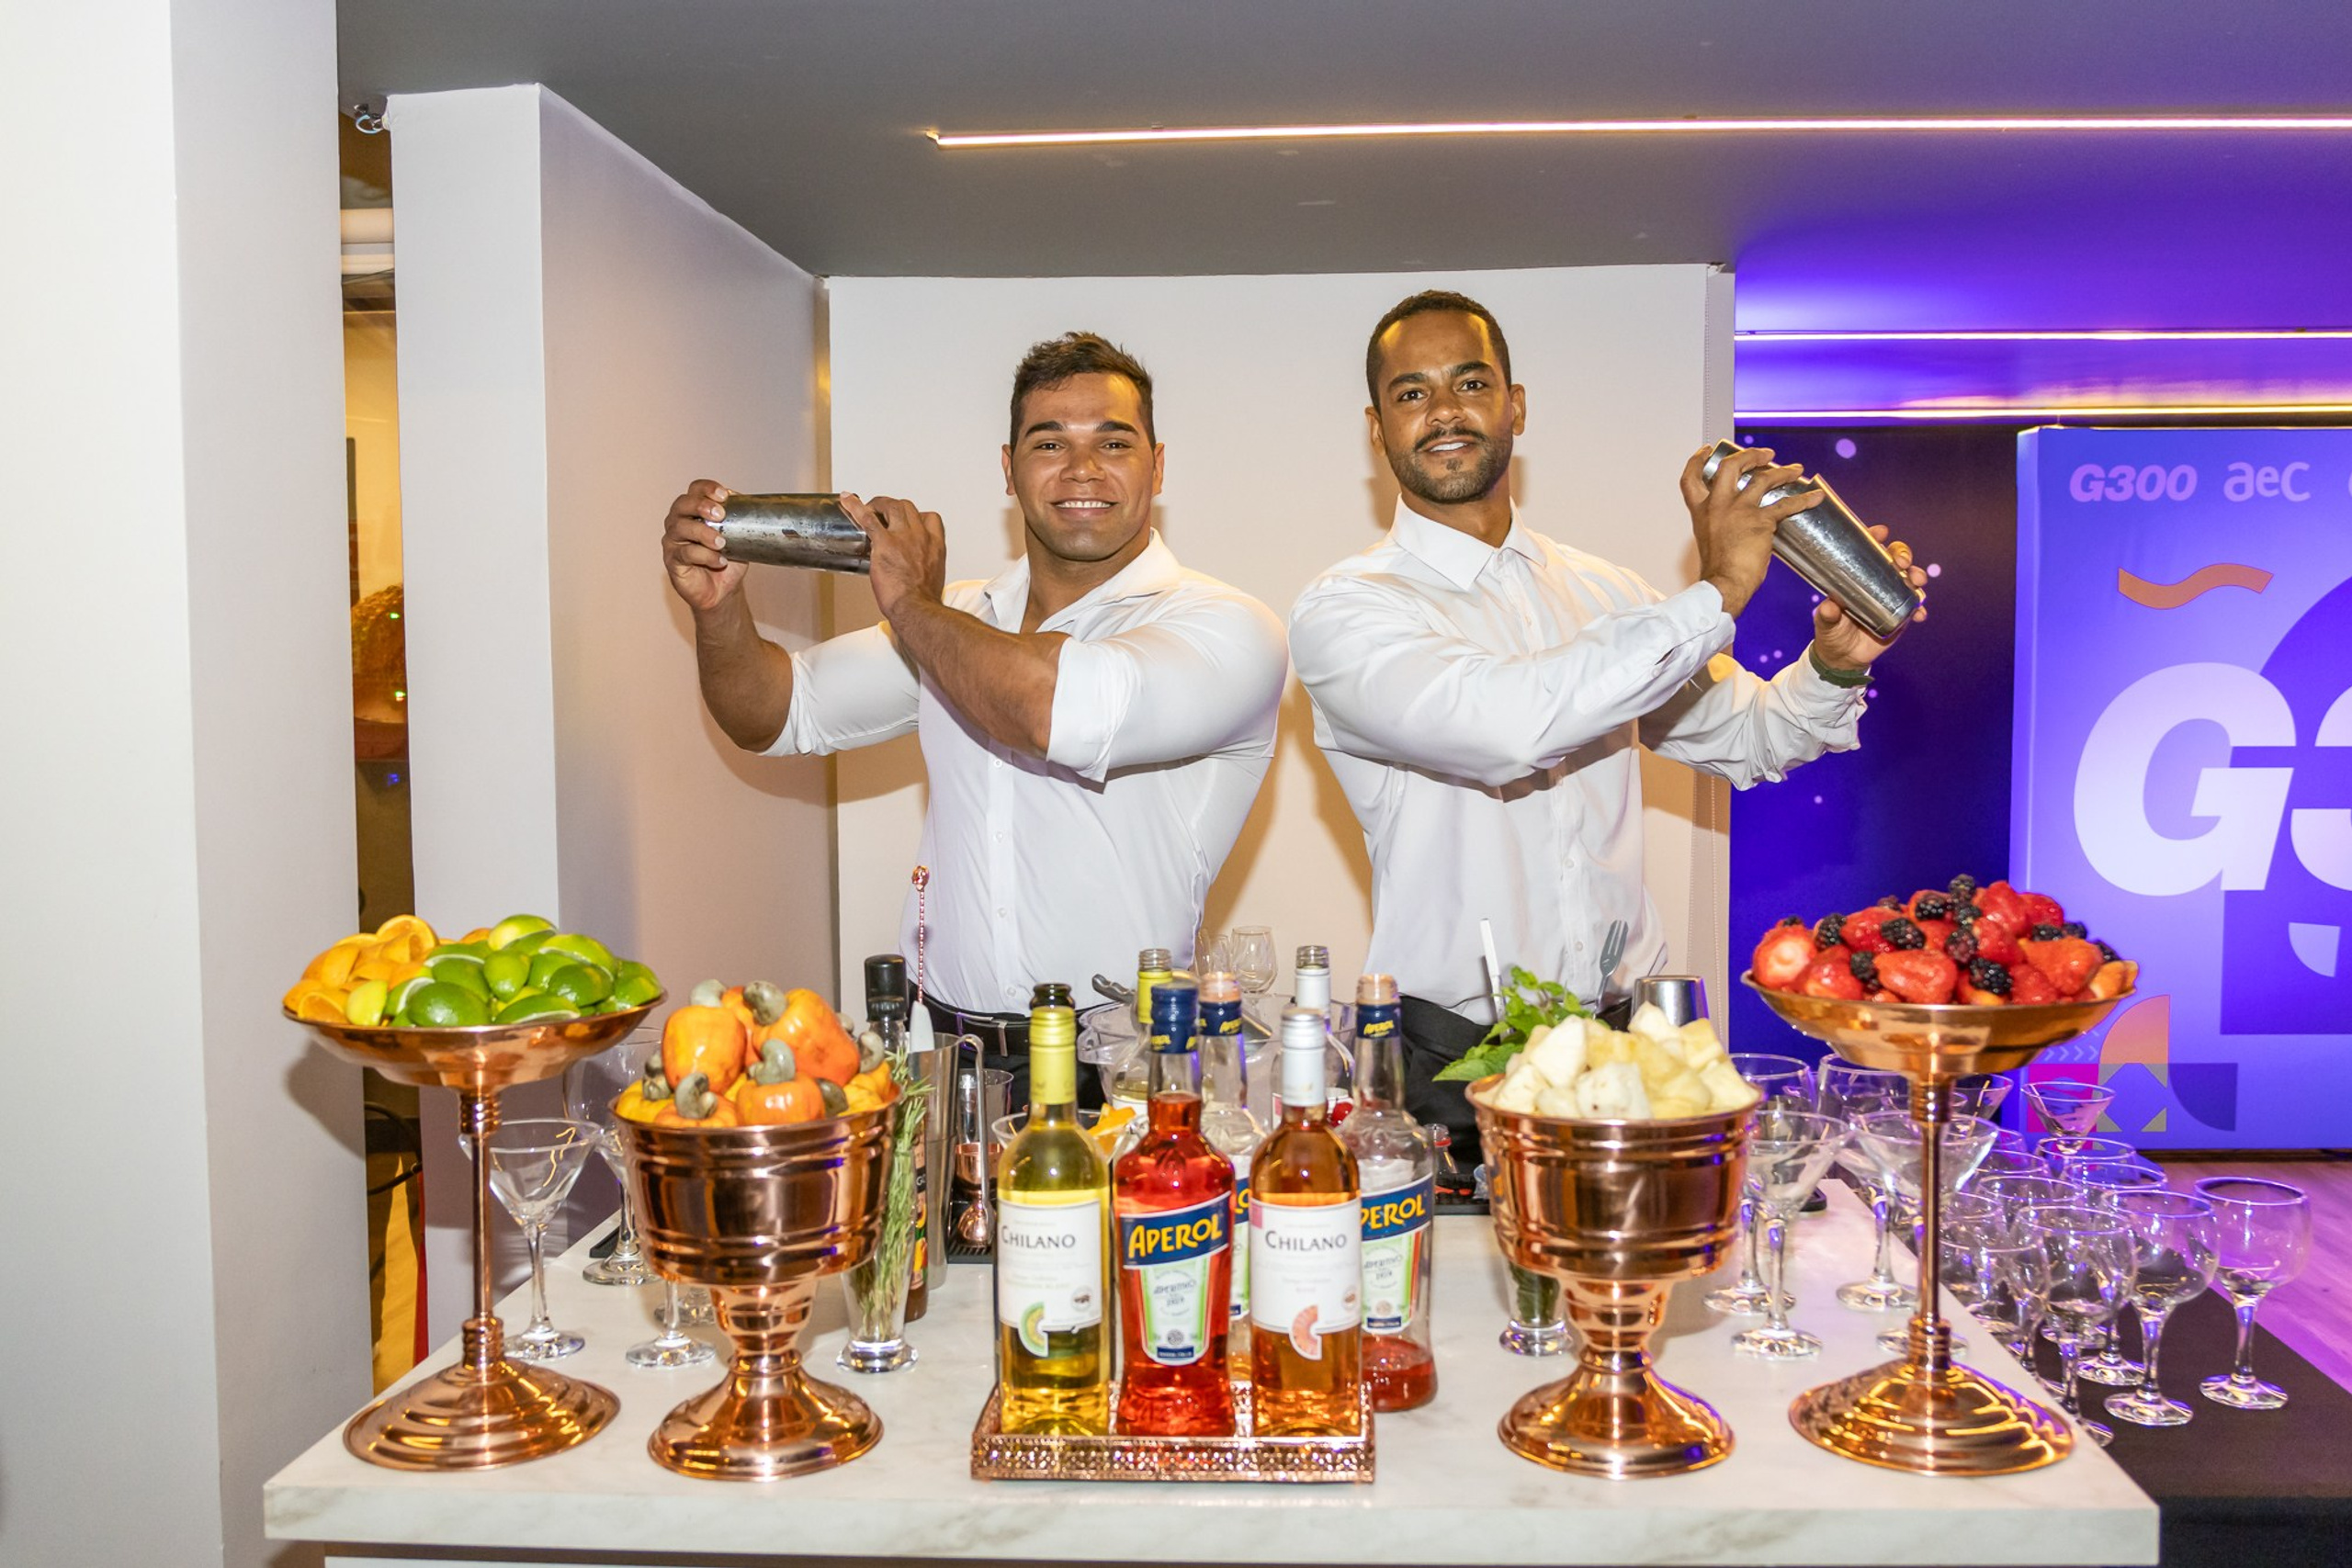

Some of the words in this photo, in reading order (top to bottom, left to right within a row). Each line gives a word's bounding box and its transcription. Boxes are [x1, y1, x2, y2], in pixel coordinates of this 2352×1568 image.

[2069, 464, 2199, 502] G300
[1361, 1194, 1426, 1230] PEROL
[1001, 1225, 1076, 1248] CHILANO
[1128, 1213, 1223, 1259] APEROL
[1265, 1230, 1348, 1251] CHILANO
